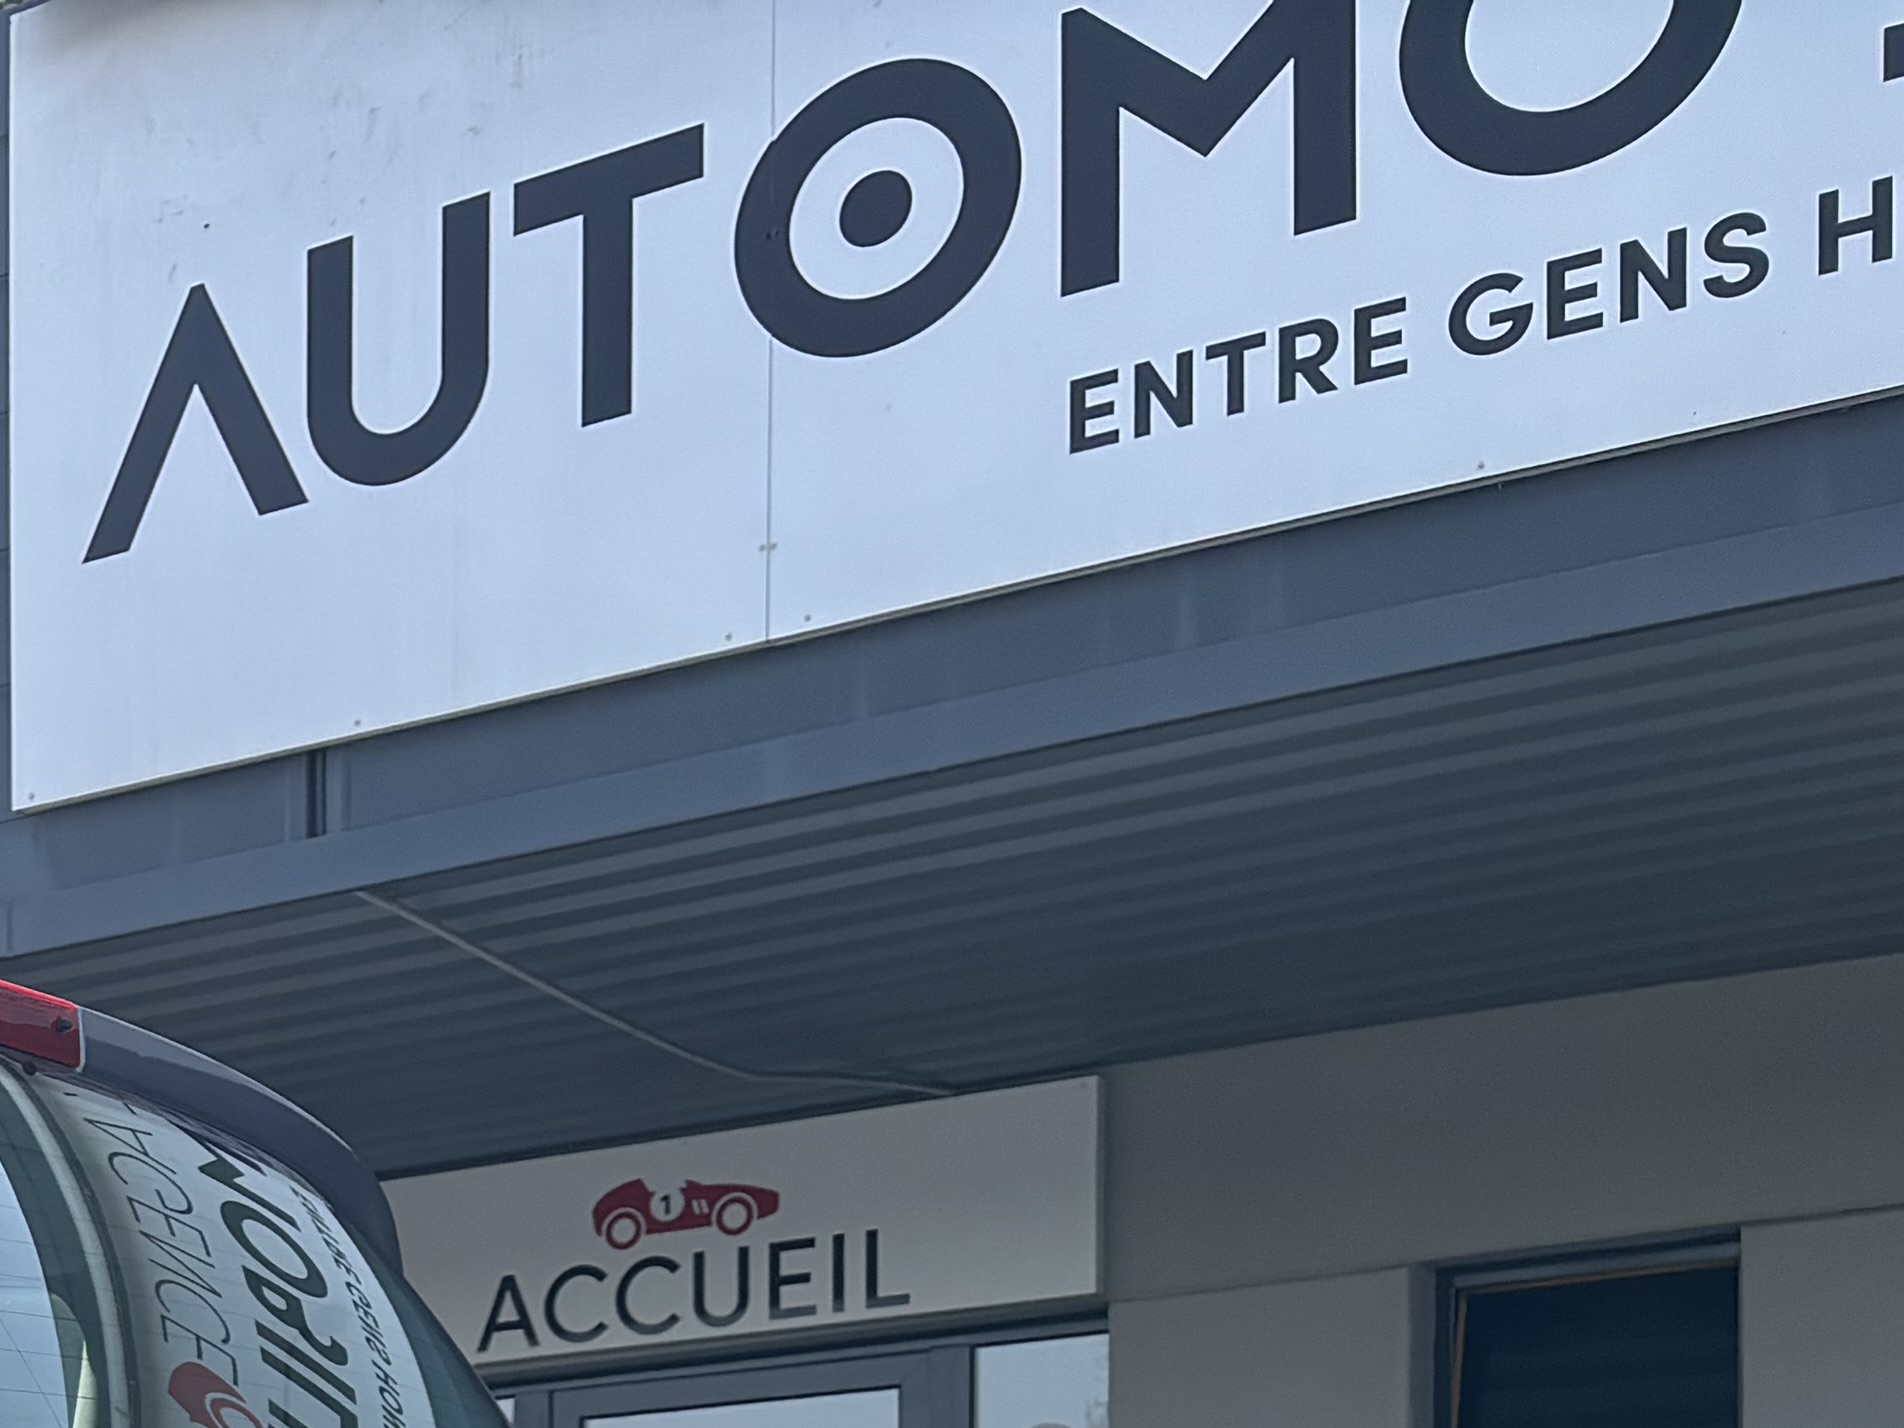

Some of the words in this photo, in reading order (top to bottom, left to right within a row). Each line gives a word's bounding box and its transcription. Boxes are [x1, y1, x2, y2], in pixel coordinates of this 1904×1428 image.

[1069, 296, 1408, 455] ENTRE
[1448, 212, 1771, 357] GENS
[477, 1228, 912, 1353] ACCUEIL
